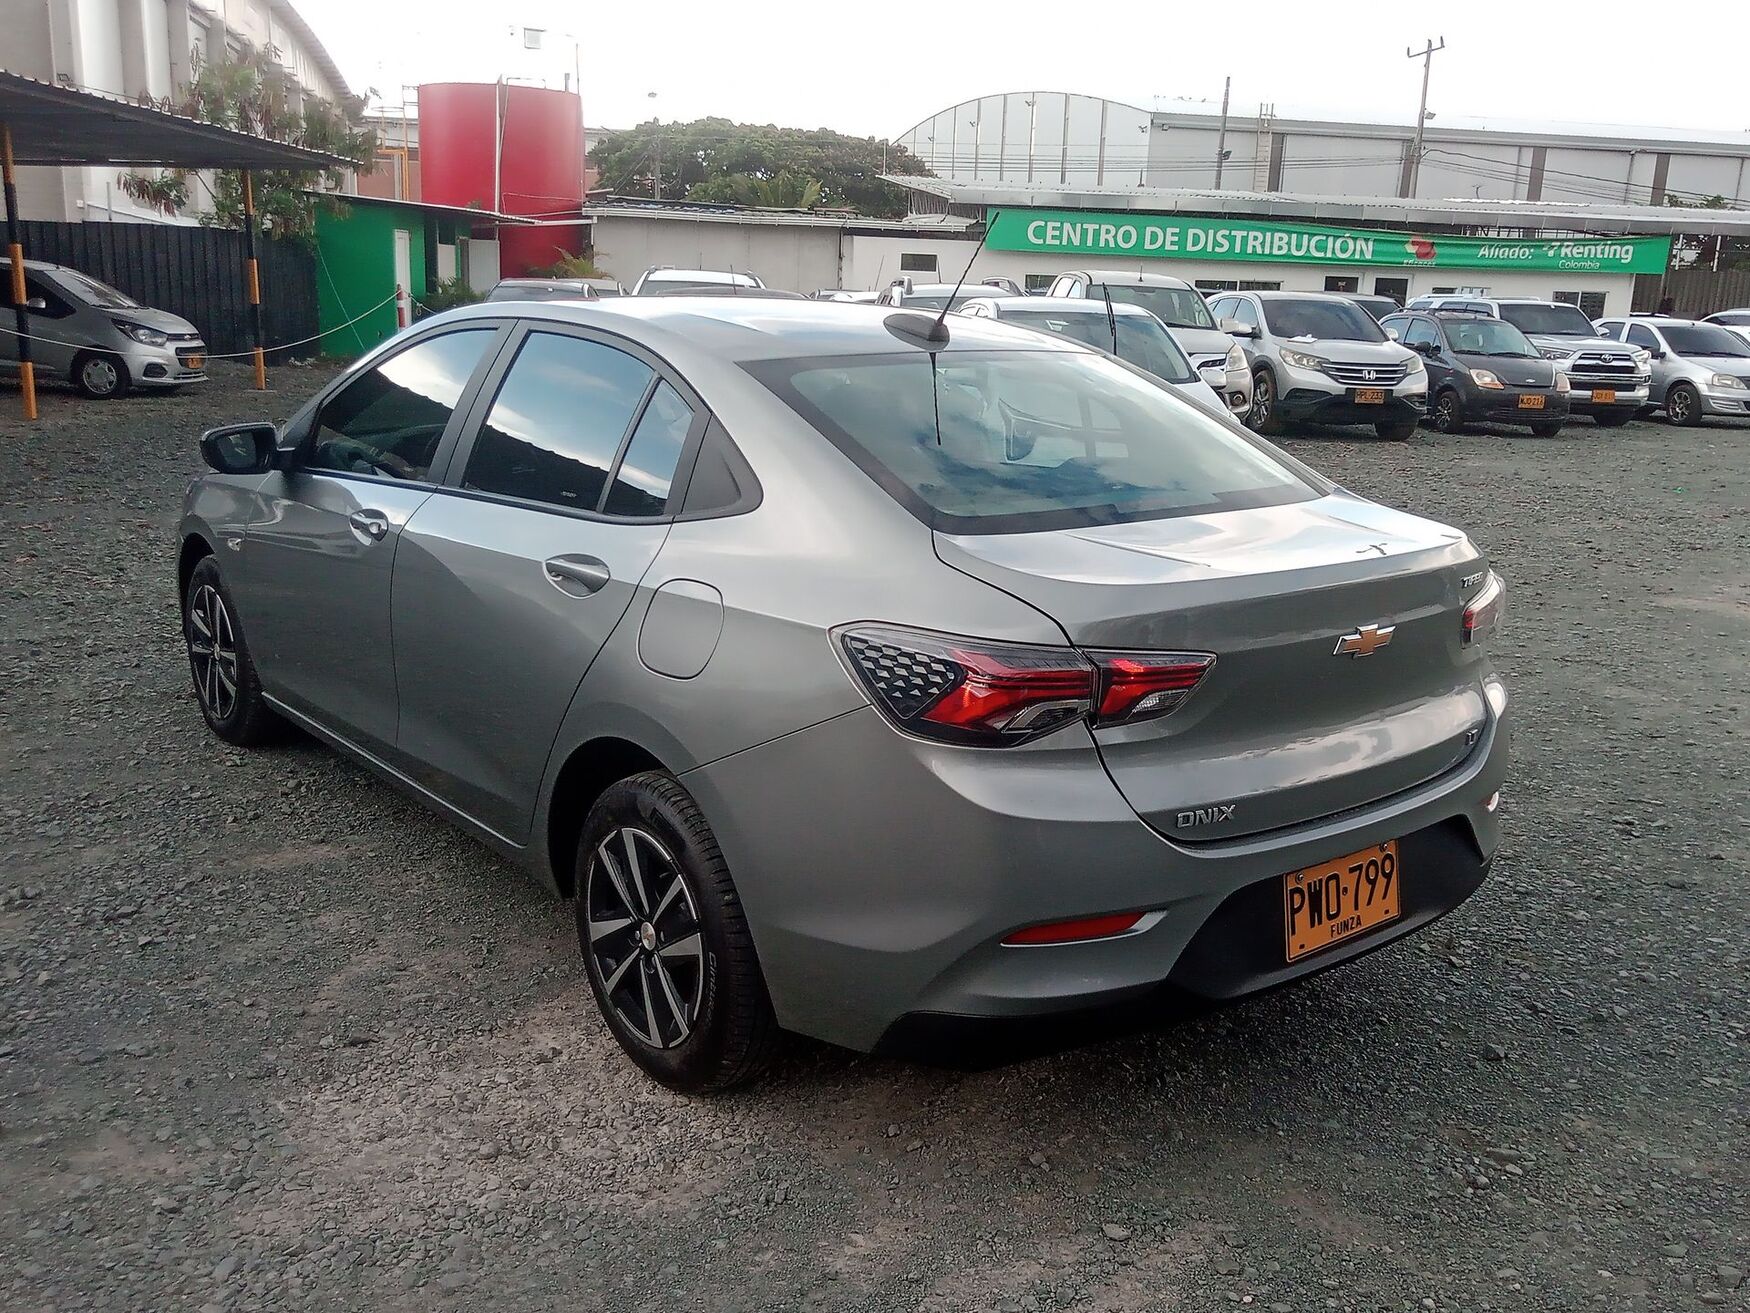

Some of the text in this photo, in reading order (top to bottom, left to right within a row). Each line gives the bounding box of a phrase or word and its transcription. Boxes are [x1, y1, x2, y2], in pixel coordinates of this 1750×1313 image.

[1027, 220, 1374, 259] CENTRO DE DISTRIBUCIÓN
[1477, 241, 1634, 263] Aliado: Renting
[1558, 260, 1600, 270] Colombia
[1177, 805, 1236, 828] ONIX
[1330, 914, 1362, 938] FUNZA
